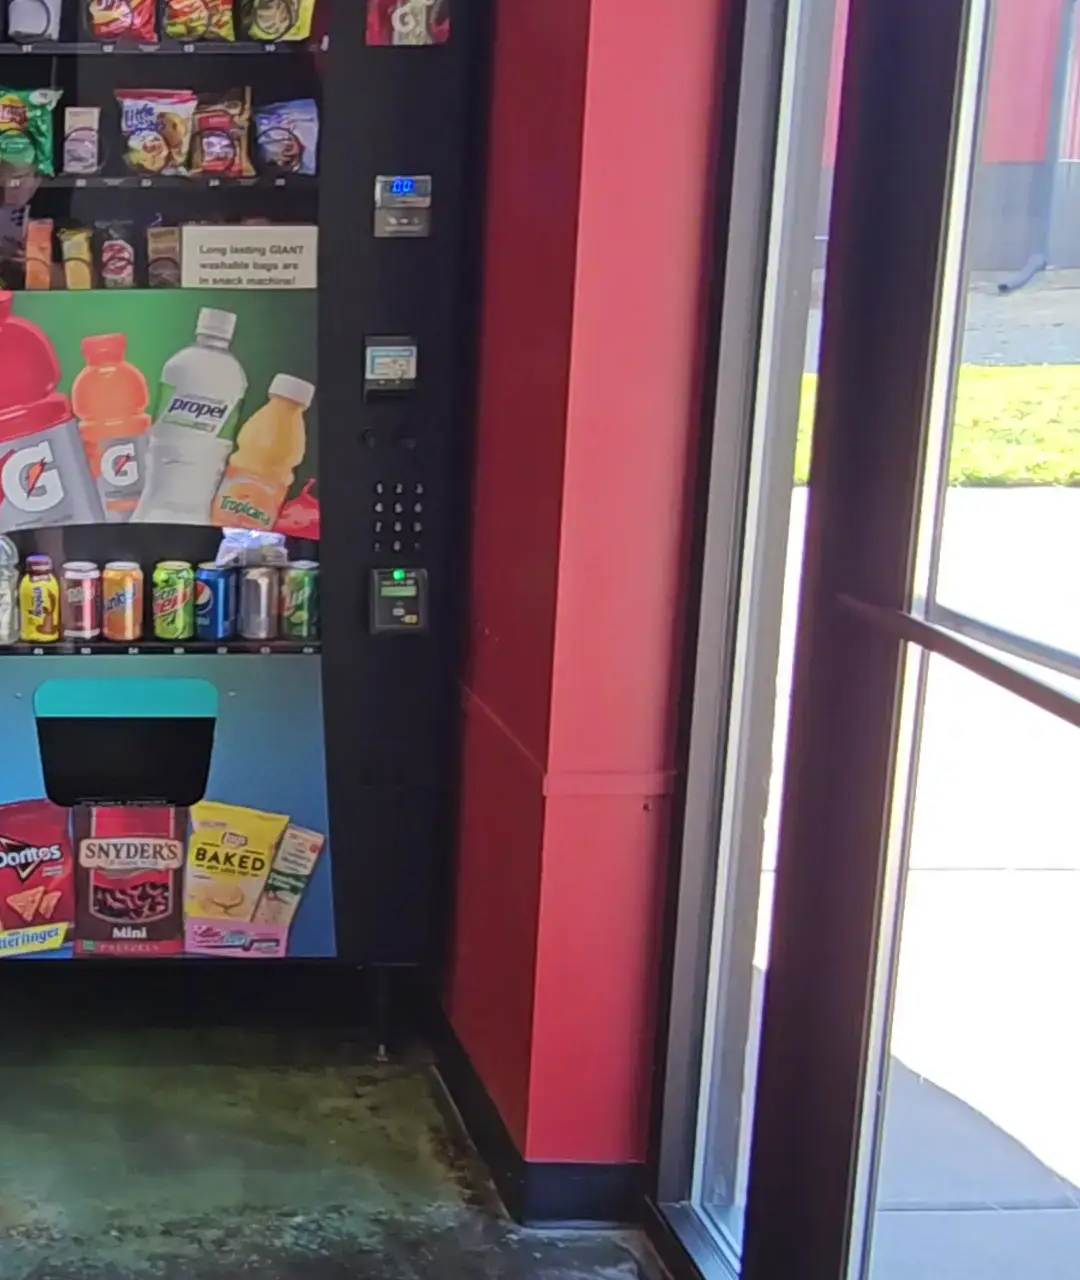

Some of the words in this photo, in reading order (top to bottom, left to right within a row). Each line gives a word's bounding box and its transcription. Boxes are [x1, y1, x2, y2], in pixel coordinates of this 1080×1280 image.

[198, 245, 227, 256] Long
[229, 245, 266, 256] lasting
[269, 245, 304, 255] GIANT
[199, 261, 249, 270] washable
[252, 261, 278, 272] bags
[168, 398, 228, 419] propel
[100, 442, 139, 487] G
[1, 440, 65, 512] G
[221, 495, 270, 526] Tropicana
[85, 842, 178, 861] SNYDER'S
[195, 847, 266, 872] BAKED
[112, 926, 147, 938] Mini
